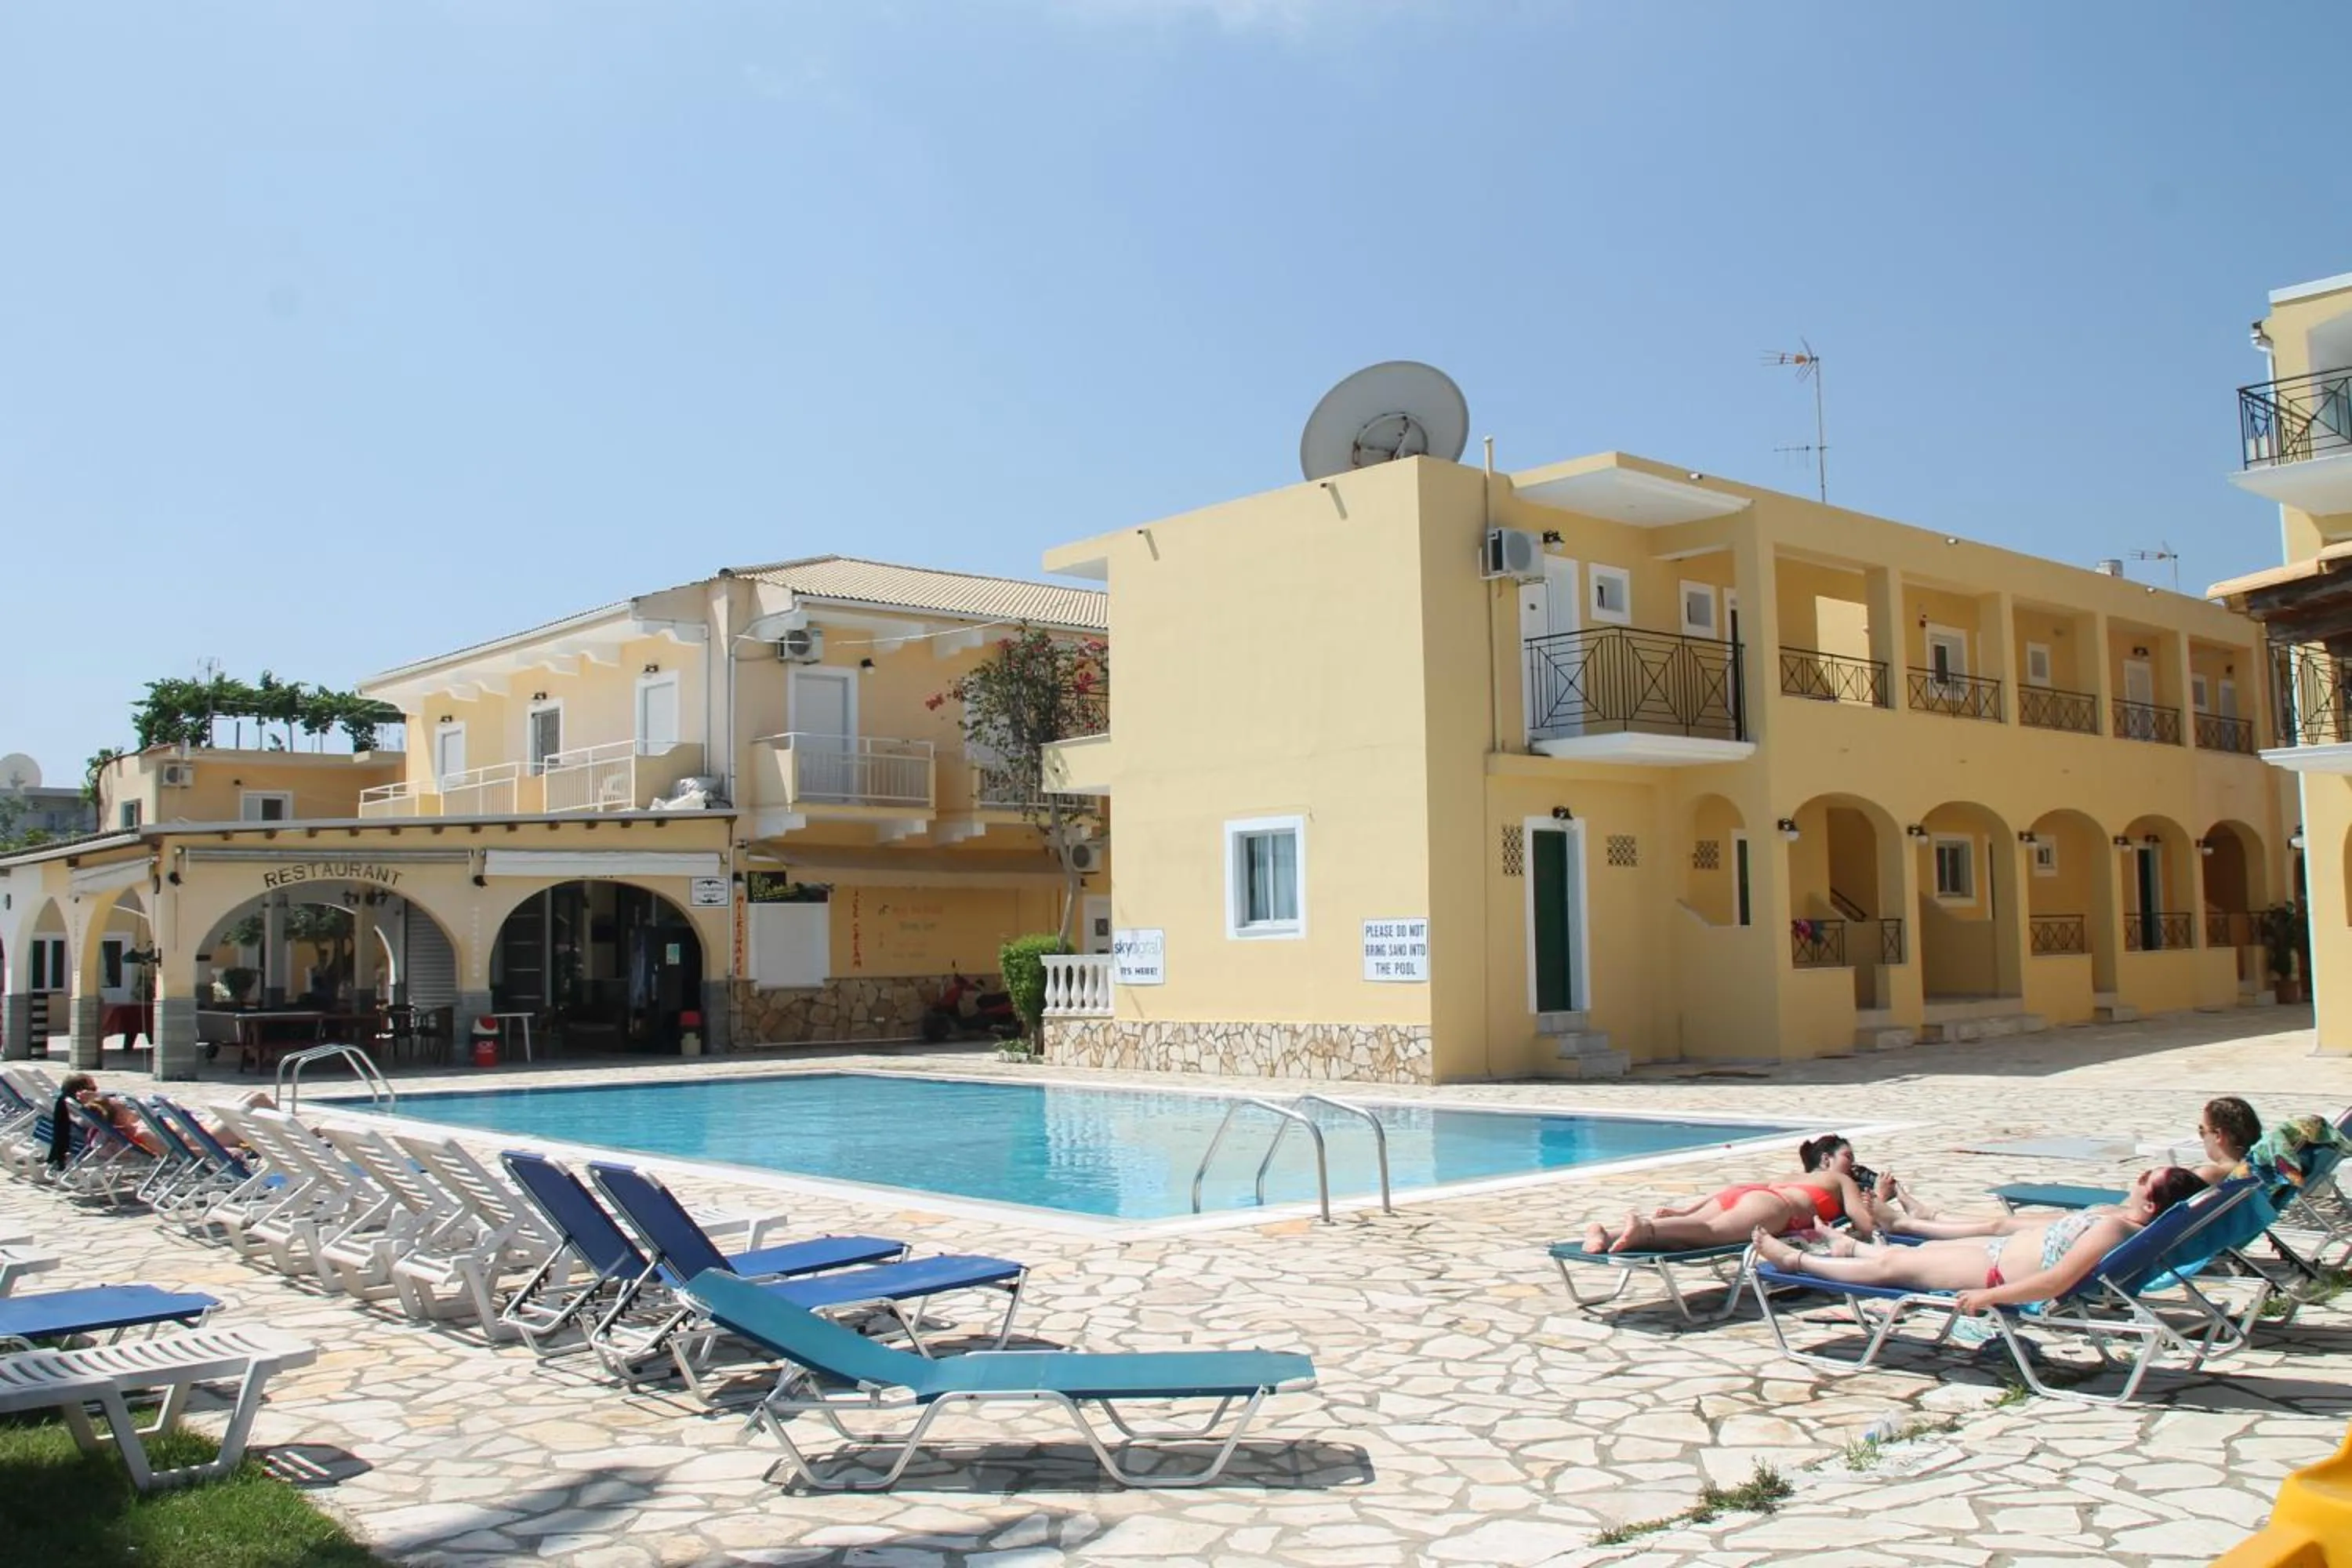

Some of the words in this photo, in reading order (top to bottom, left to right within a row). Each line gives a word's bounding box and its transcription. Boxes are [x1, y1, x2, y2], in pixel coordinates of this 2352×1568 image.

[263, 863, 404, 888] RESTAURANT
[1365, 924, 1393, 938] PLEASE
[1396, 924, 1406, 938] DO
[1409, 924, 1425, 938] NOT
[1365, 943, 1386, 956] BRING
[1388, 943, 1406, 956] SAND
[1409, 943, 1426, 957] INTO
[1375, 961, 1391, 975] THE
[1394, 961, 1417, 975] POOL
